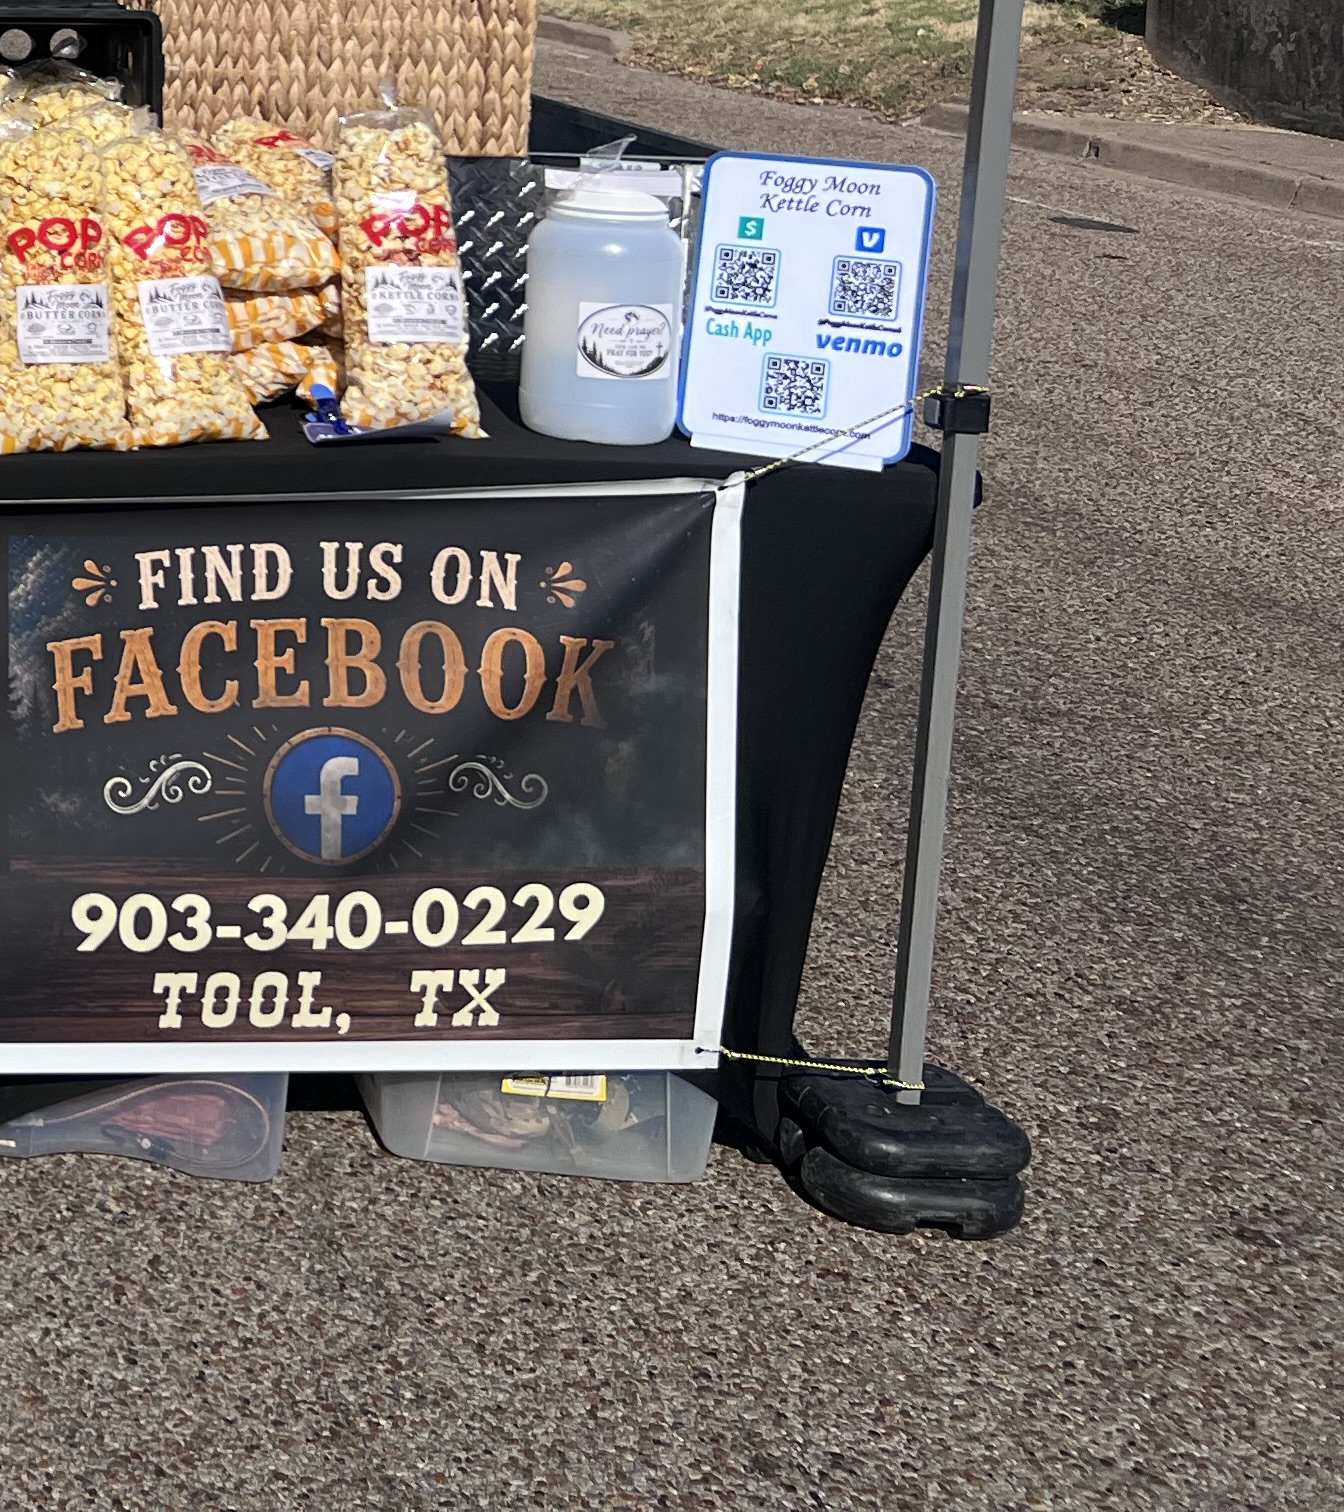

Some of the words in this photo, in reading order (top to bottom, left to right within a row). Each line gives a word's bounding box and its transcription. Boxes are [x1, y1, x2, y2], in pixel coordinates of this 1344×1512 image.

[759, 170, 818, 195] Foggy
[822, 175, 881, 196] Moon
[759, 192, 820, 213] Kettle
[826, 199, 872, 218] Corn
[7, 217, 103, 265] POP
[150, 300, 199, 315] BUTTER
[378, 291, 425, 302] KETTLE
[26, 309, 75, 321] BUTTER
[77, 309, 104, 320] CORN
[591, 322, 625, 339] Need
[625, 321, 666, 341] prayer?
[705, 317, 739, 339] Cash
[743, 321, 772, 347] App
[816, 332, 903, 358] venmo
[134, 541, 294, 611] FIND
[319, 541, 404, 602] US
[429, 546, 522, 611] ON
[46, 616, 616, 735] FACEBOOK
[70, 882, 606, 952] 903-340-0229
[153, 970, 353, 1035] TOOL,
[410, 968, 507, 1028] TX
